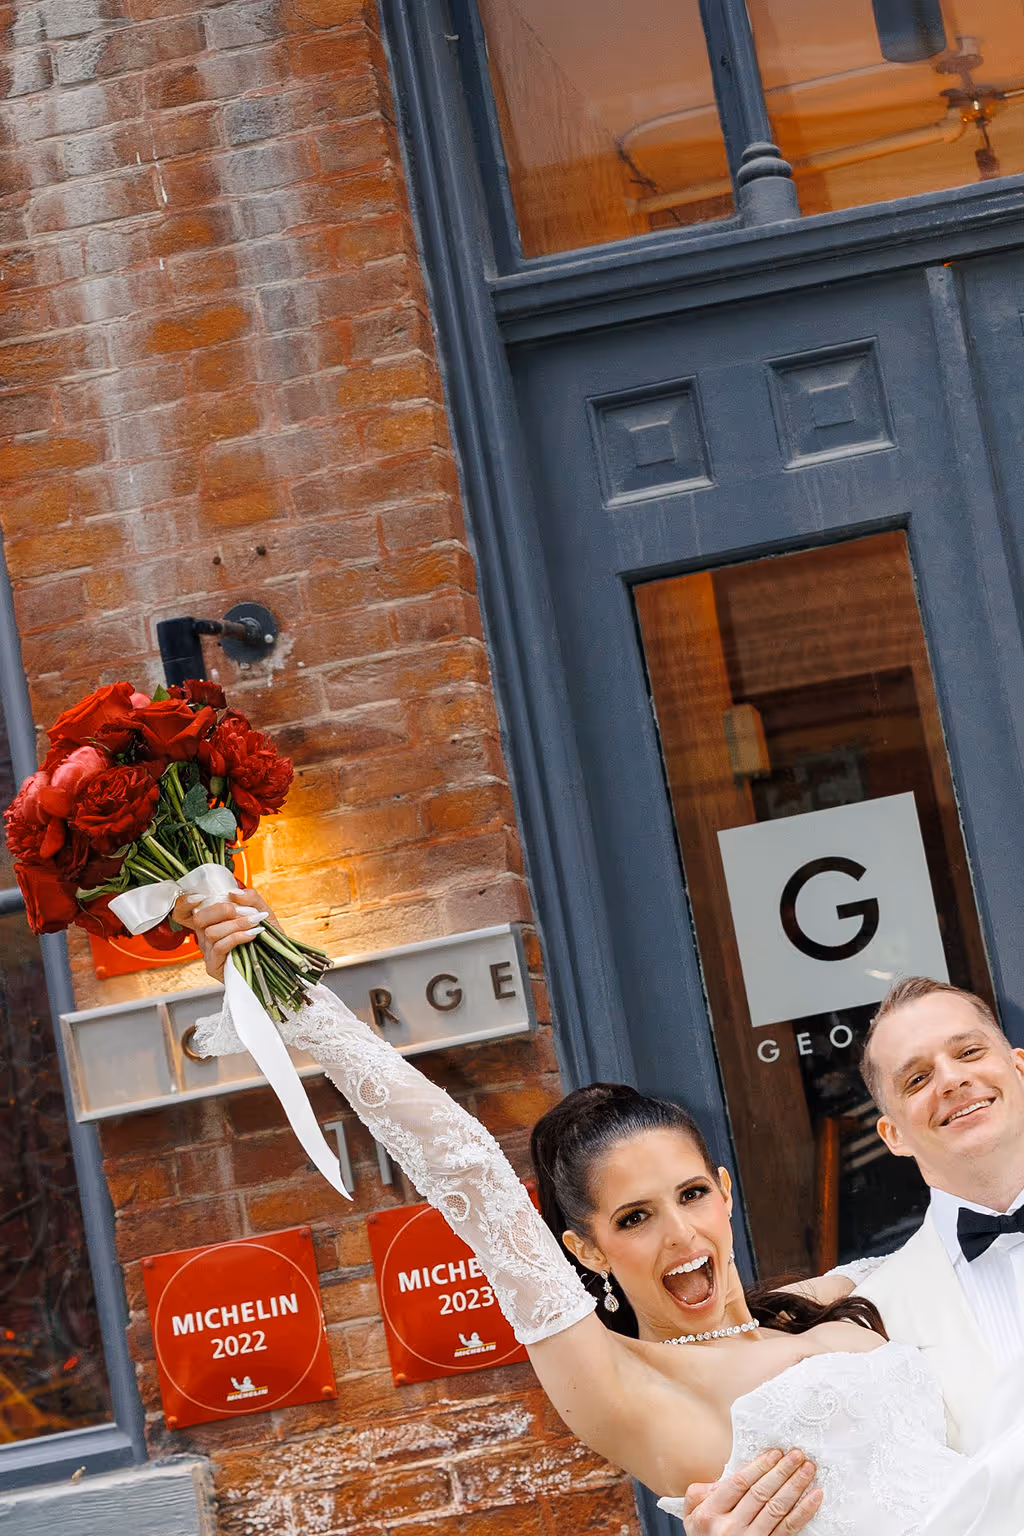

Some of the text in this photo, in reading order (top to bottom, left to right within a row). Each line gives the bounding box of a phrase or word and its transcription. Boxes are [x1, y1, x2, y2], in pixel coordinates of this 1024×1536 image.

[779, 856, 880, 962] G
[757, 1019, 875, 1063] GEO
[398, 1257, 484, 1293] MICHE
[172, 1293, 299, 1336] MICHELIN
[438, 1286, 495, 1315] 2023
[211, 1330, 267, 1359] 2022
[454, 1344, 497, 1358] MICHELIN
[226, 1385, 268, 1401] MICHELIN
